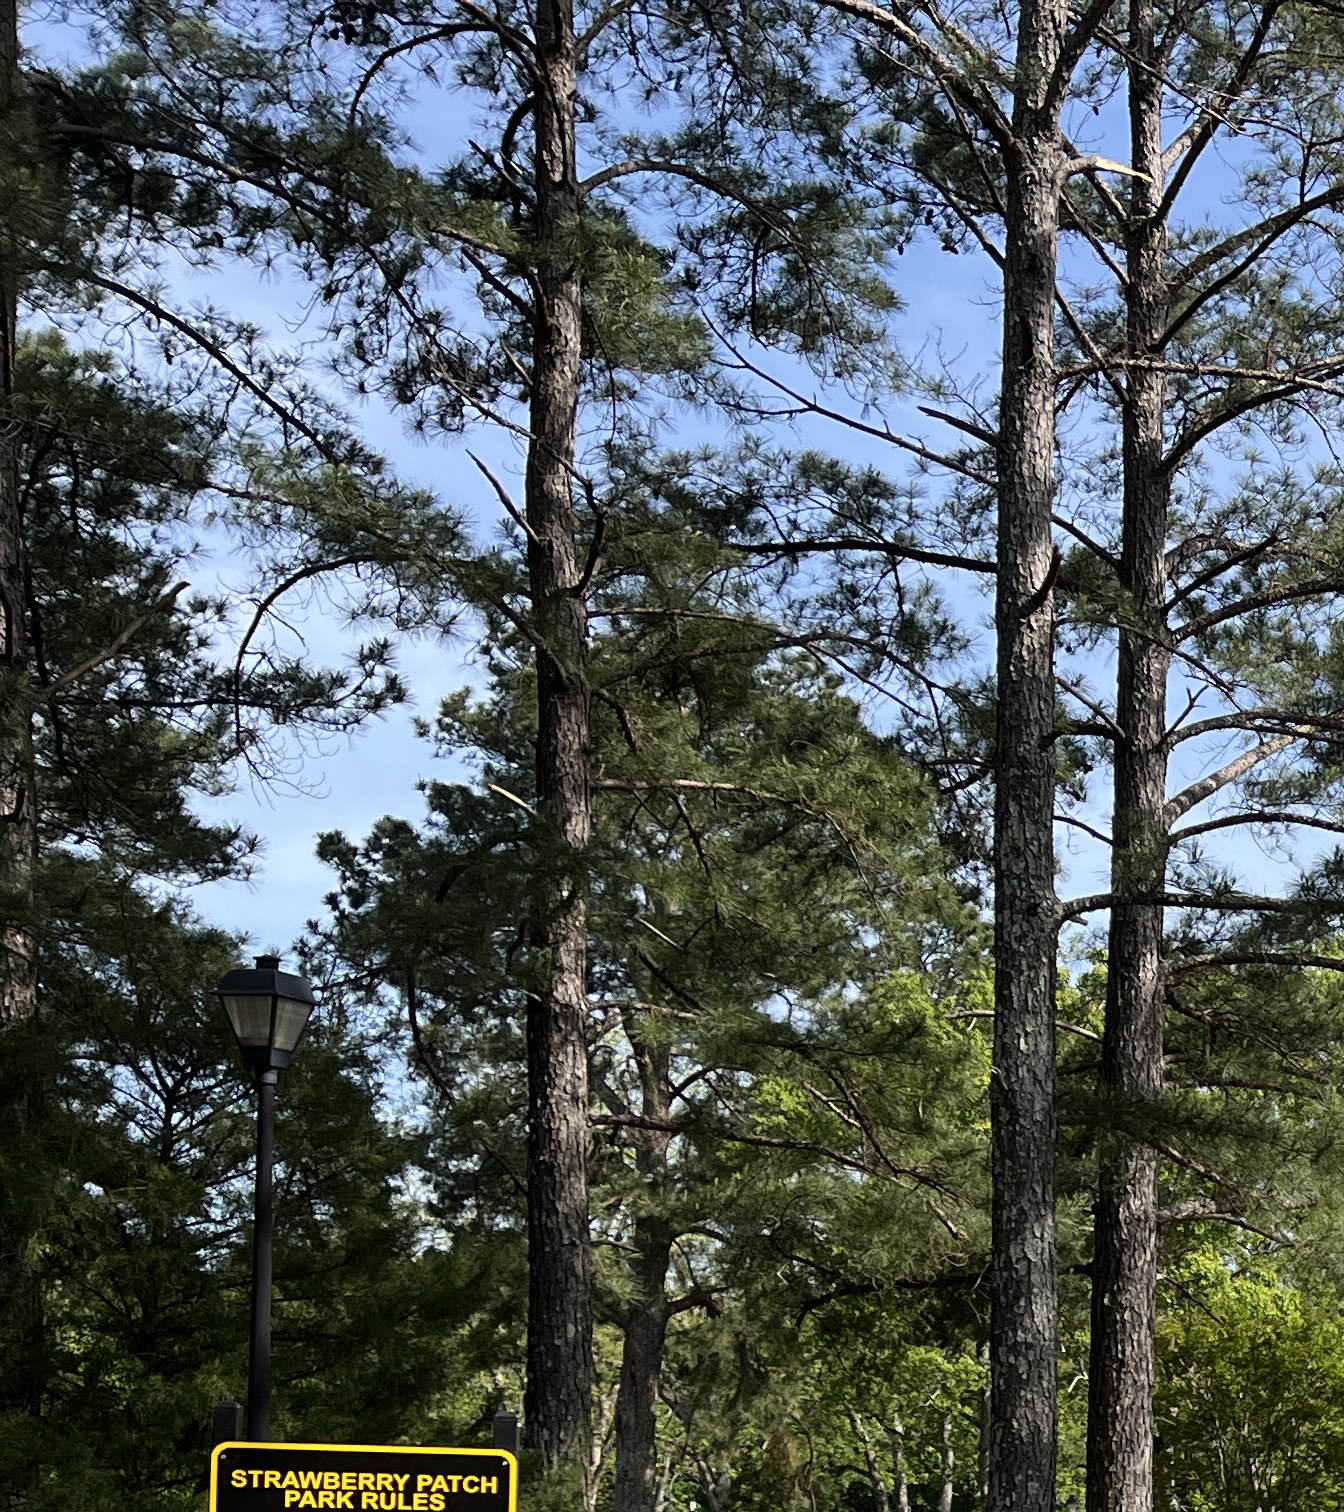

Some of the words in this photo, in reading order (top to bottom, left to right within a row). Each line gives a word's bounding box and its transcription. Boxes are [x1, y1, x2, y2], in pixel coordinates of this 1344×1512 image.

[231, 1470, 410, 1492] STRAWBERRY
[415, 1474, 498, 1495] PATCH
[285, 1489, 354, 1509] PARK
[362, 1491, 447, 1511] RULES
